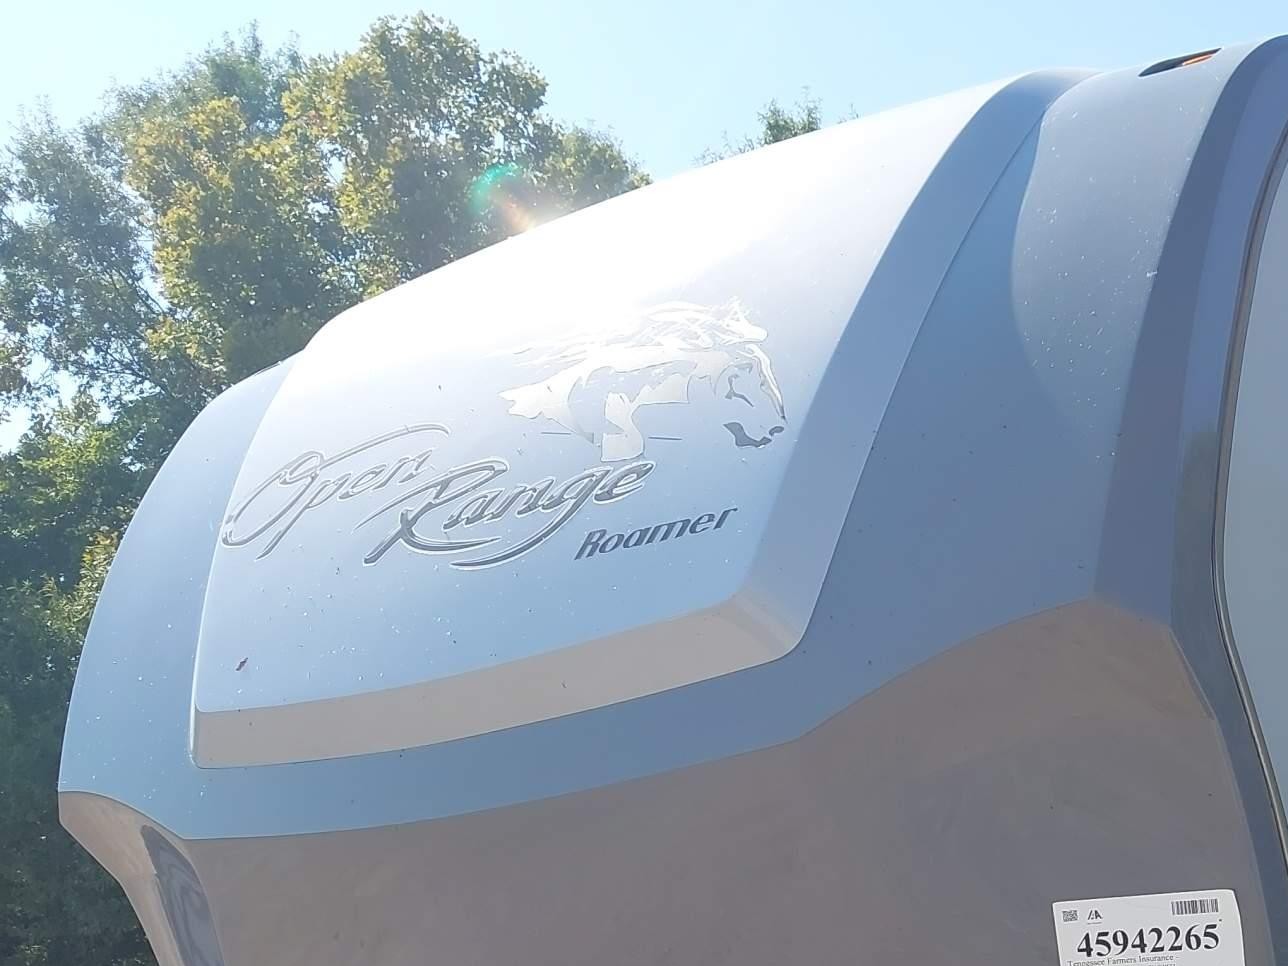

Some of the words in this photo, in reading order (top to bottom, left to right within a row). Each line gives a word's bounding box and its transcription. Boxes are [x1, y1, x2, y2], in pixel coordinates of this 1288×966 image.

[221, 423, 450, 560] Open
[356, 459, 656, 569] Range
[574, 507, 738, 561] Roamer
[1077, 923, 1220, 958] 45942265
[1107, 957, 1137, 966] Farmers
[1138, 955, 1174, 963] Insurance
